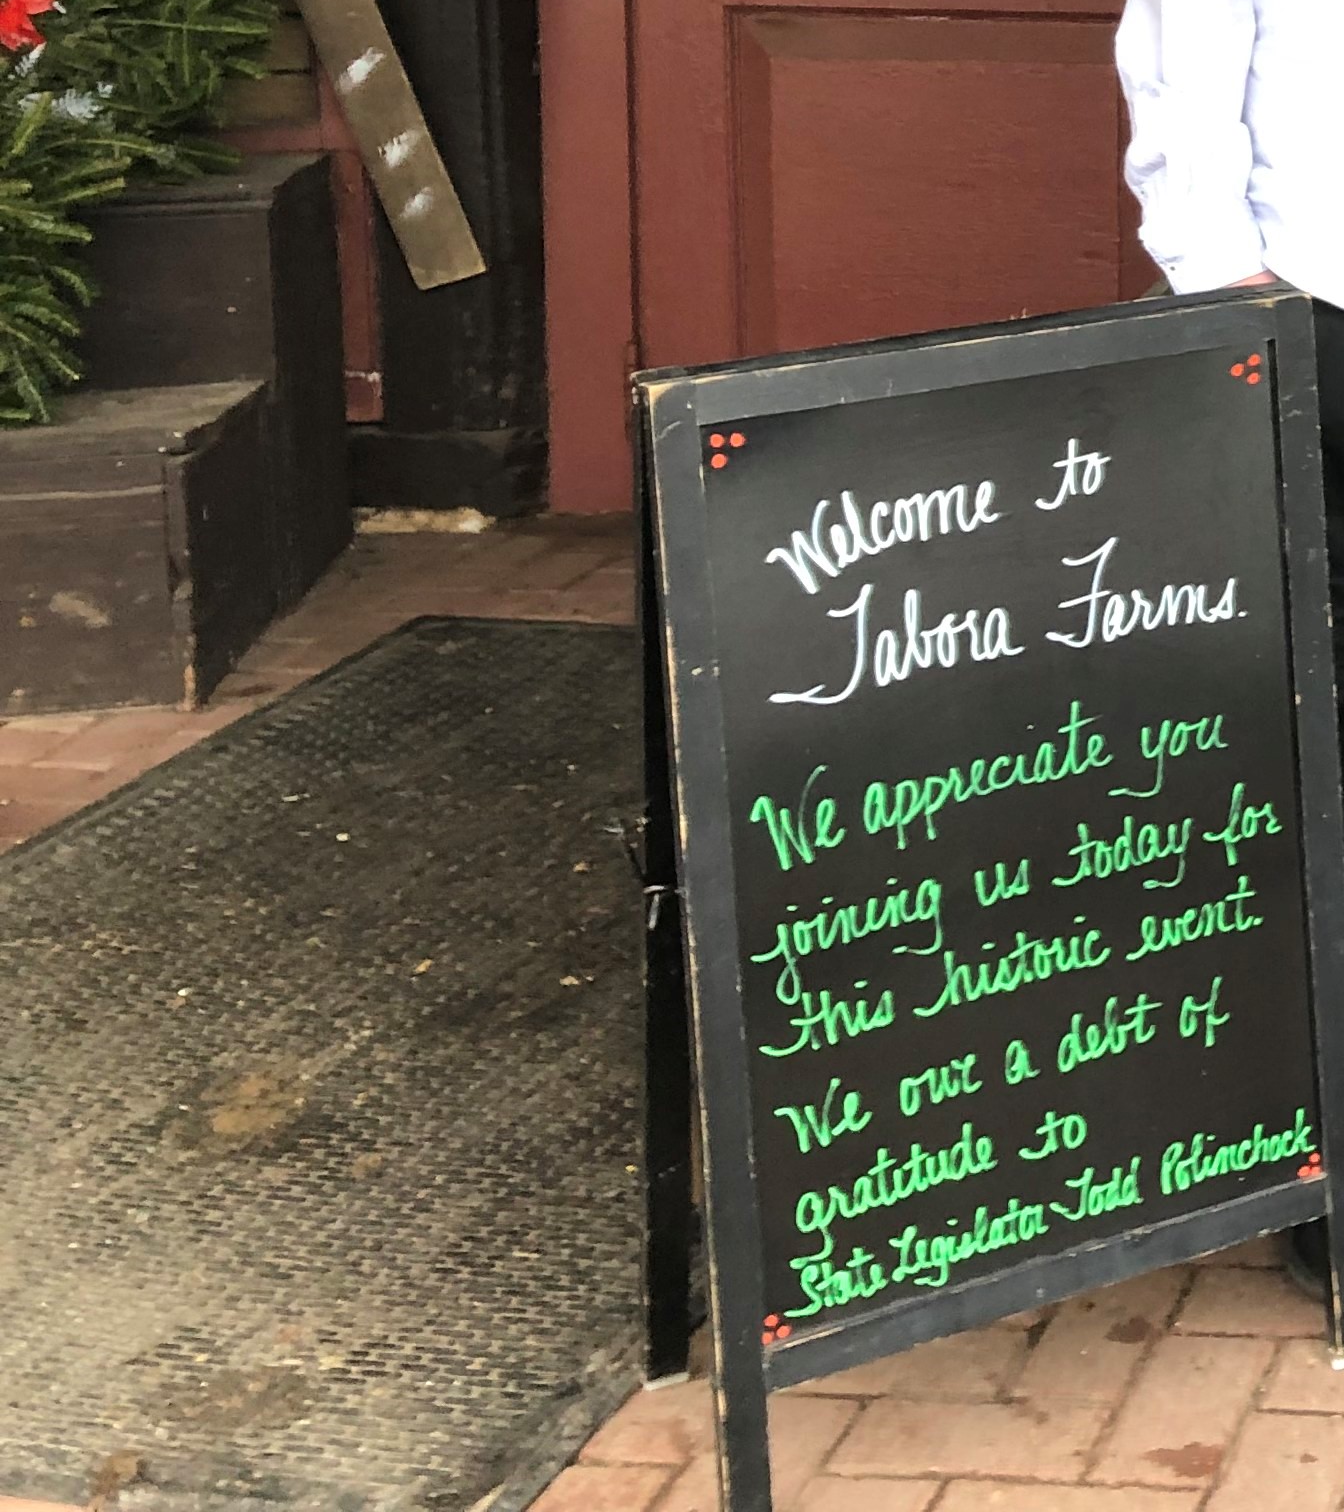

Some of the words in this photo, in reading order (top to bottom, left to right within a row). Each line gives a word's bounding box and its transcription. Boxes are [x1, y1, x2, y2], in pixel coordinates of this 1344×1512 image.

[765, 479, 1003, 594] Welcome
[1035, 437, 1111, 511] to
[767, 584, 1025, 705] Tabora
[1045, 537, 1248, 648] Farms.
[749, 764, 847, 871] We
[864, 701, 1114, 850] appreciate
[1108, 714, 1229, 799] you
[750, 878, 944, 1005] joining
[974, 858, 1031, 907] us
[1052, 815, 1194, 890] today
[1202, 782, 1283, 866] for
[759, 980, 896, 1058] this
[913, 916, 1112, 1017] historic
[1126, 875, 1264, 961] event.
[774, 1078, 873, 1153] We
[900, 1053, 983, 1117] owe
[1004, 1040, 1040, 1085] a
[1058, 994, 1164, 1073] debt
[1179, 976, 1230, 1049] of
[783, 1248, 888, 1318] State
[890, 1192, 1049, 1289] Legislator
[1050, 1156, 1144, 1221] Todd
[789, 1122, 998, 1270] gratitude
[1018, 1110, 1087, 1162] to
